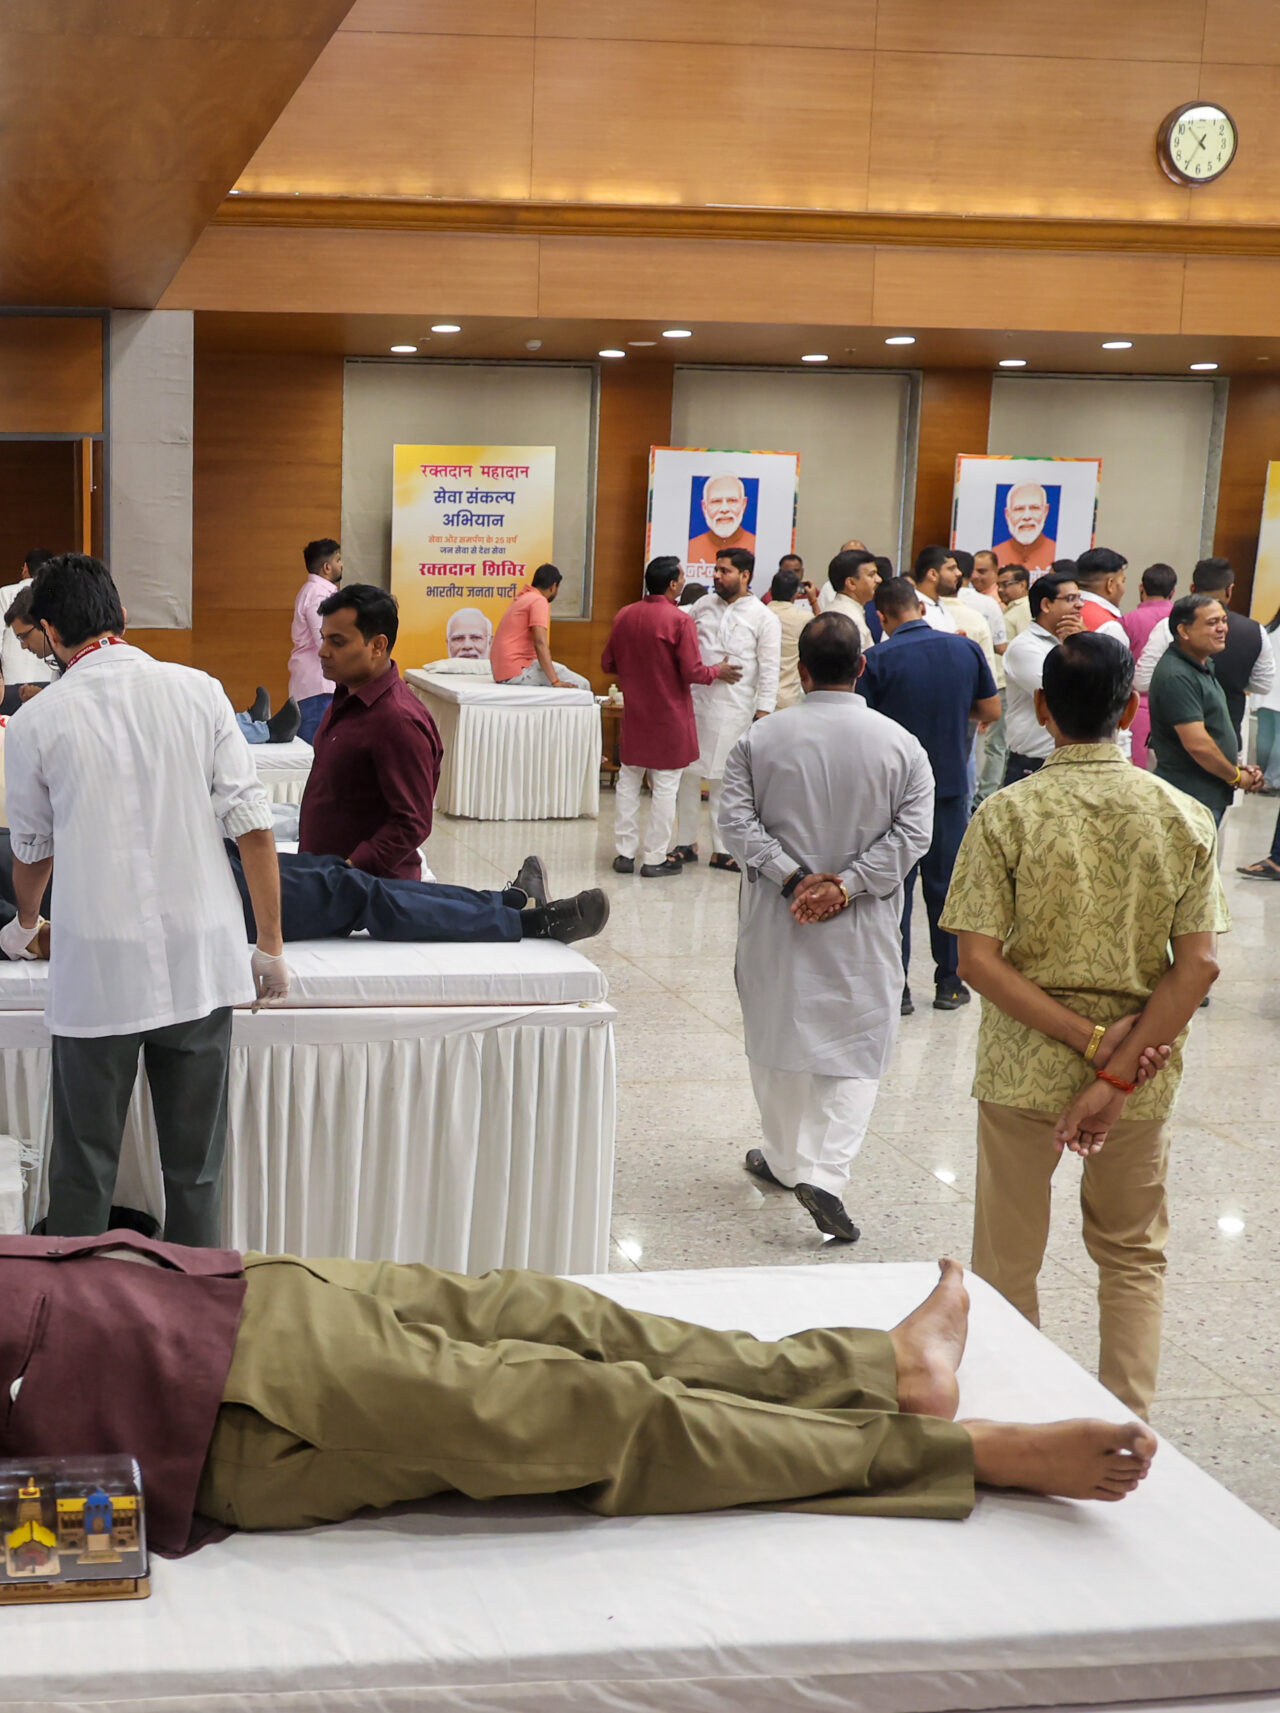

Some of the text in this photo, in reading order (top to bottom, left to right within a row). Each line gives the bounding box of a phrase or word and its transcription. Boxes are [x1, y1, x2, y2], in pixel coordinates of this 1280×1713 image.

[1179, 123, 1186, 135] 10
[1219, 124, 1225, 136] 2
[1174, 137, 1180, 148] 9
[1221, 138, 1226, 149] 3
[1176, 150, 1182, 161] 8
[1217, 151, 1222, 162] 4
[1184, 160, 1190, 170] 7
[1195, 163, 1201, 175] 6
[1207, 160, 1213, 171] 5
[420, 464, 530, 480] रक्तदान महादान
[433, 486, 516, 505] सेवा संकल्प
[443, 509, 504, 528] अभियान
[455, 545, 469, 554] सेवा
[470, 545, 477, 554] से
[492, 545, 506, 554] सेवा
[419, 560, 527, 577] रक्तदान शिविर
[426, 582, 518, 598] भारतीय जनता पार्टी
